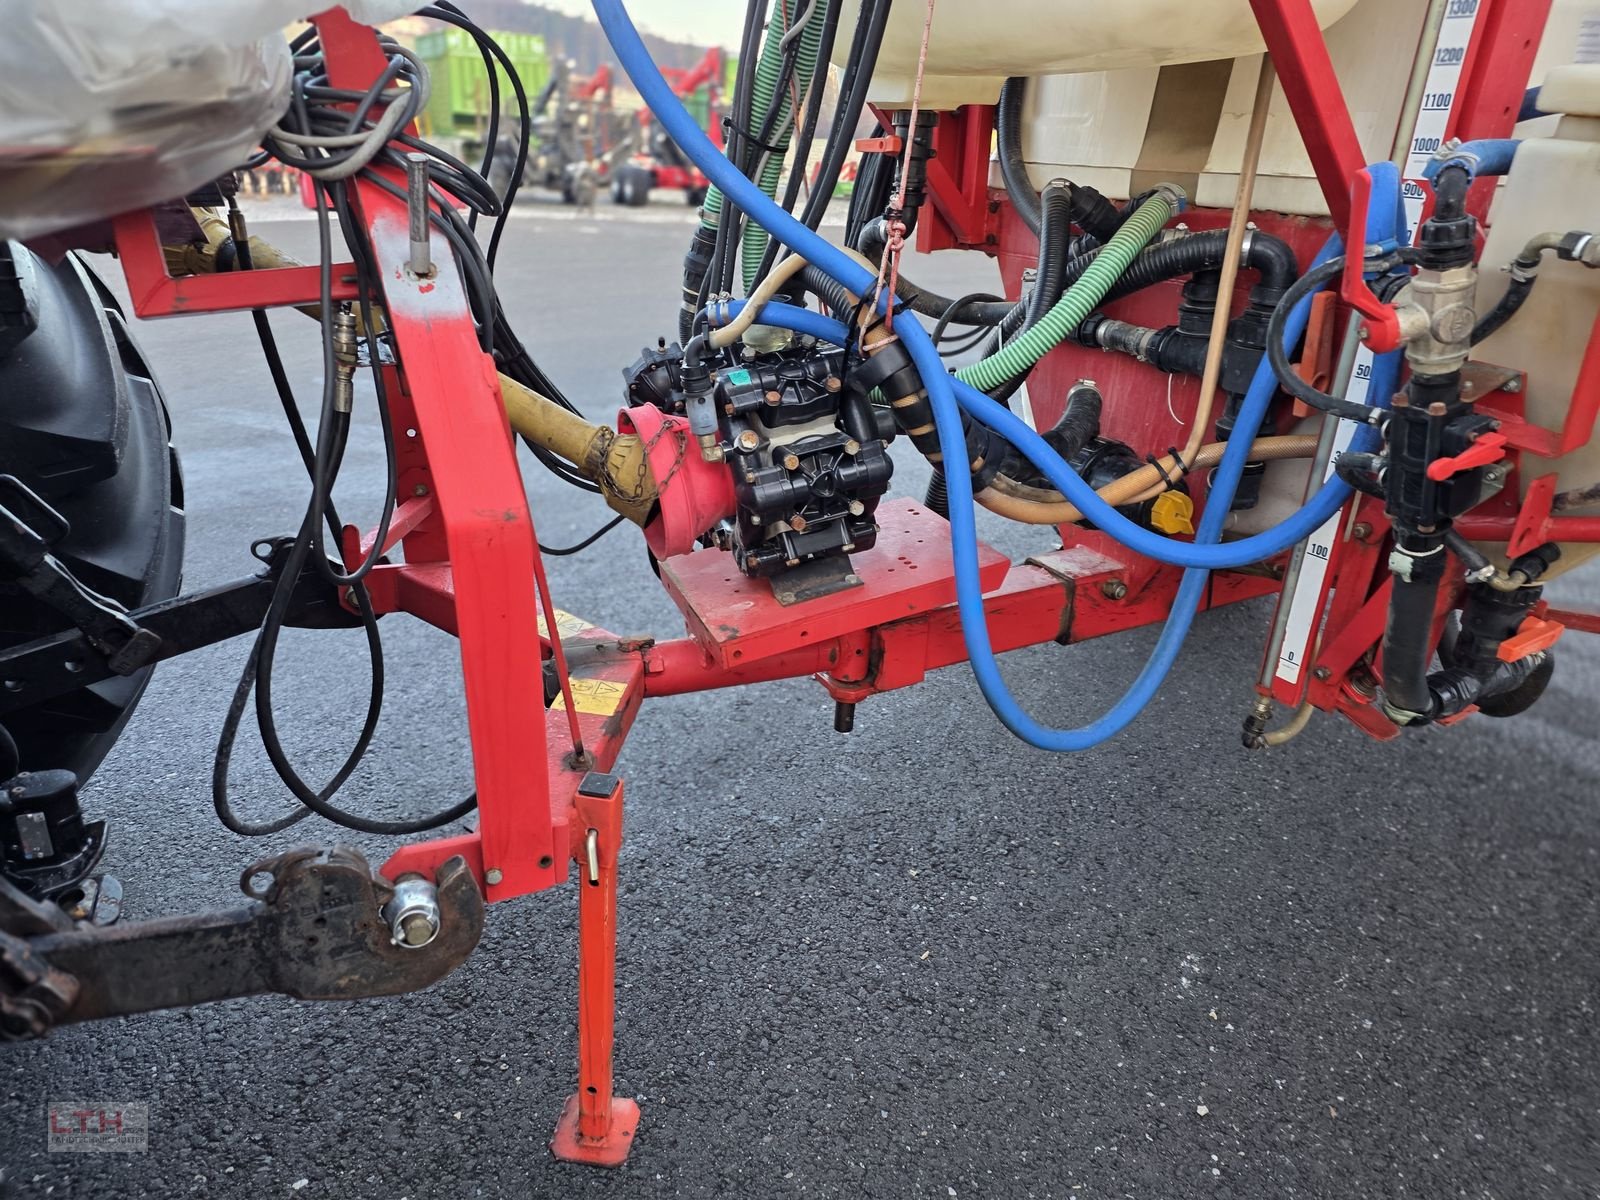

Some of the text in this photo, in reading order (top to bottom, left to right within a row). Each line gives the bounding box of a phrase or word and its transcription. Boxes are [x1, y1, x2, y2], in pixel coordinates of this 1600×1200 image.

[1448, 0, 1478, 15] 1300
[1436, 47, 1464, 62] 1200
[1424, 93, 1452, 107] 1100
[1413, 138, 1440, 151] 1000
[1403, 183, 1424, 197] 900
[1356, 364, 1371, 377] 50
[1311, 543, 1329, 558] 100
[1288, 651, 1295, 661] 0
